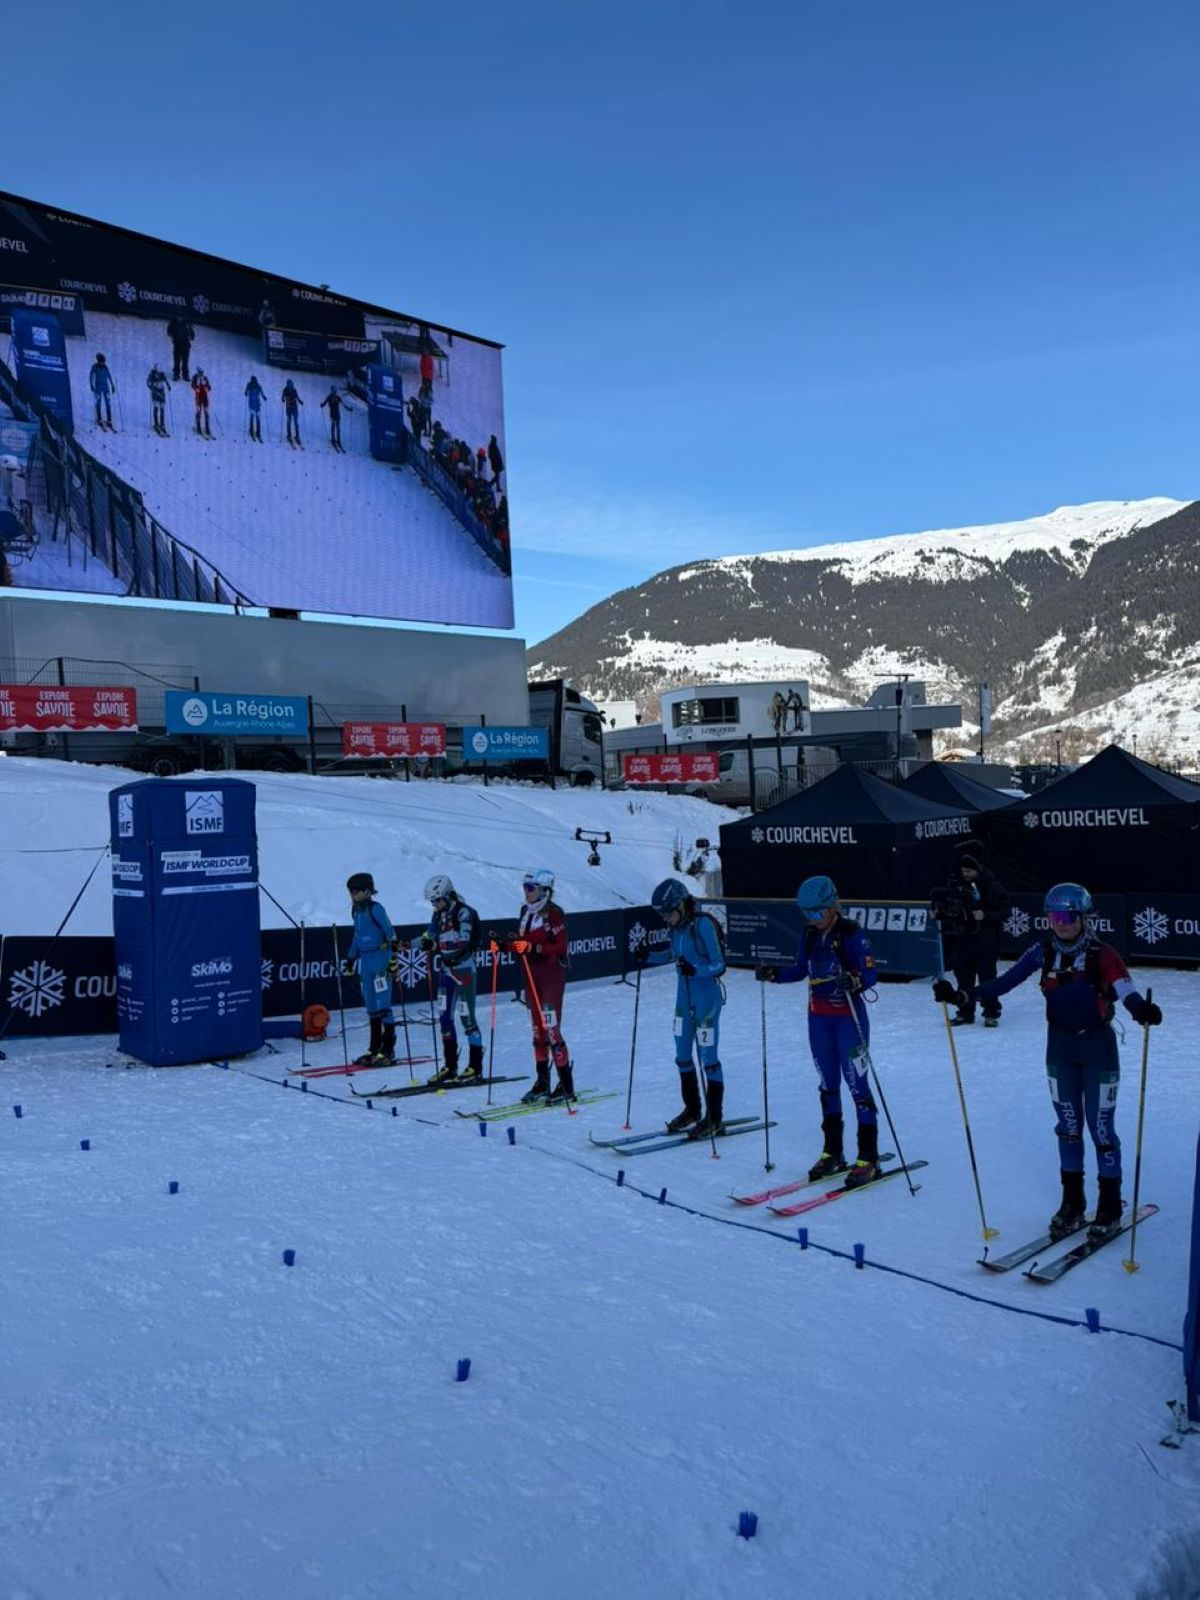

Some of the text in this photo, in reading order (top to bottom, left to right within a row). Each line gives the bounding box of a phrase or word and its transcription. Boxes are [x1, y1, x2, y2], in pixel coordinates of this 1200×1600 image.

[139, 289, 187, 306] COURCHEVEL
[35, 701, 76, 717] SAVOIE
[92, 702, 130, 717] SAVOIE
[212, 699, 294, 719] La Région
[490, 731, 539, 747] La Région
[190, 818, 223, 832] ISMF
[1041, 807, 1150, 828] COURCHEVEL
[766, 826, 857, 844] COURCHEVEL
[924, 816, 972, 839] COURCHEVEL
[167, 857, 248, 871] ISMF WORLD CUP
[568, 935, 617, 955] URCHEVEL
[191, 961, 232, 977] SkiMo
[75, 975, 117, 998] COU
[701, 1030, 708, 1043] 2
